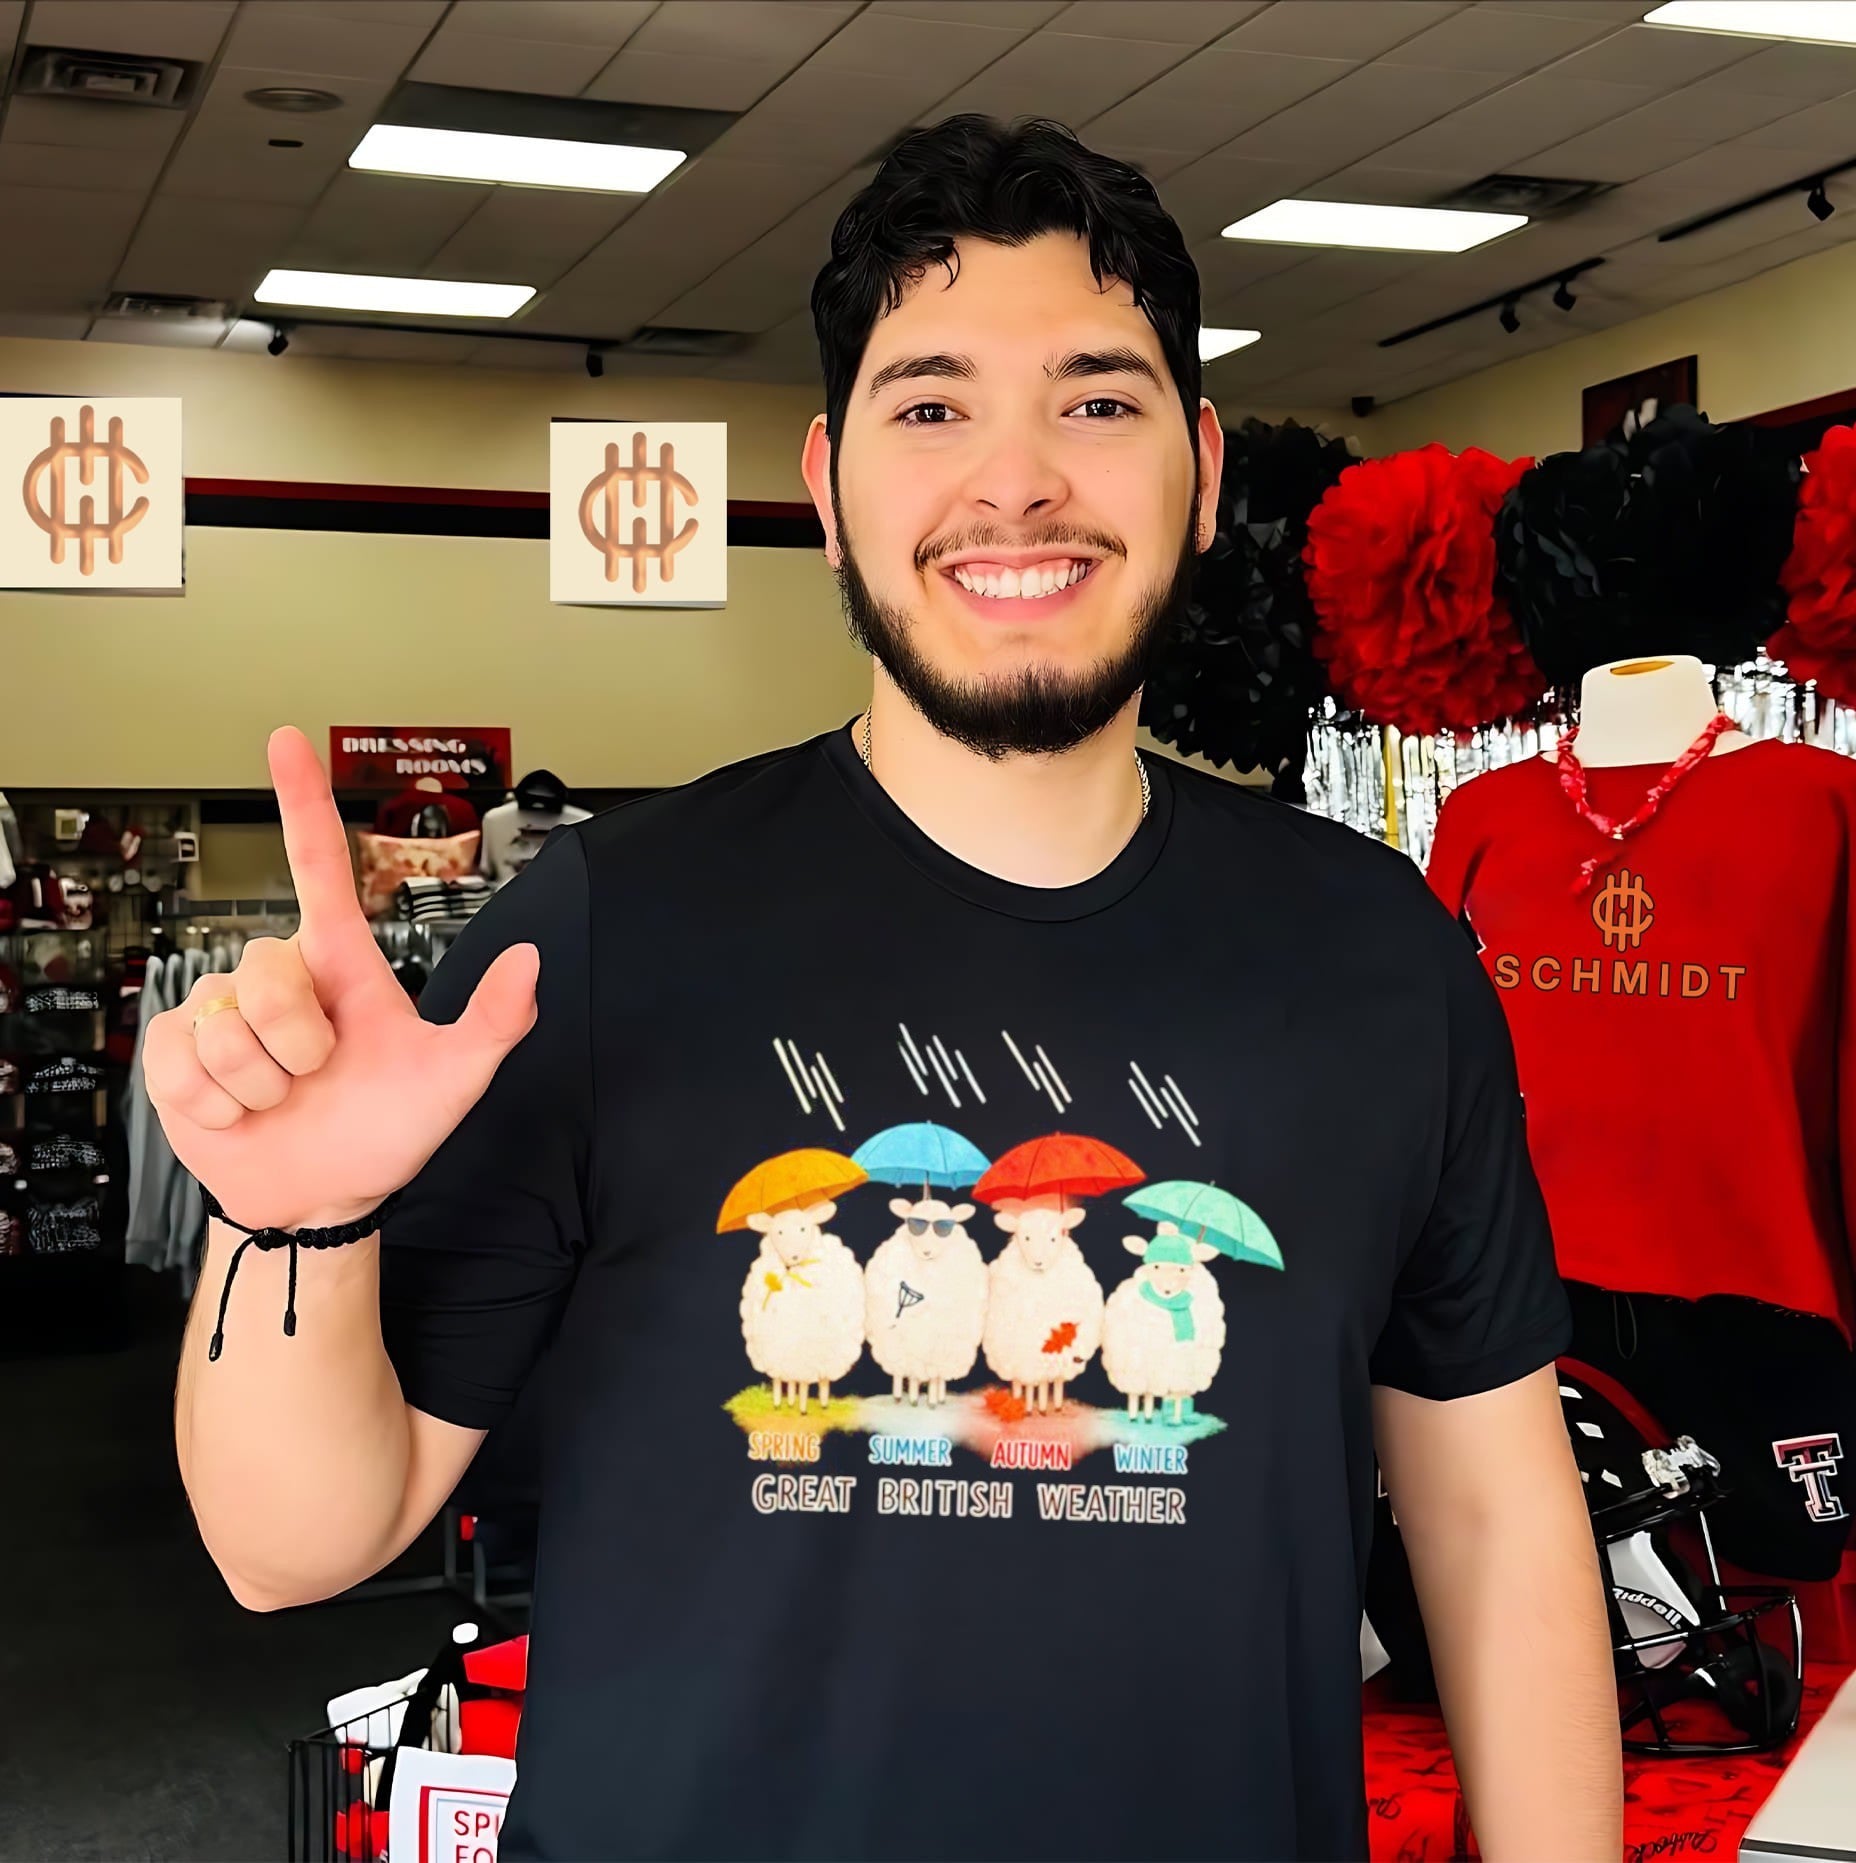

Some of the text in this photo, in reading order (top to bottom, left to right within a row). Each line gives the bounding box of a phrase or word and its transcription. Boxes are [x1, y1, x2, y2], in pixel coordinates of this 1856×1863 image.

[396, 758, 487, 774] ROOMS
[1494, 954, 1747, 1000] SCHMIDT
[748, 1431, 1188, 1474] SPRING SUMMER AUTUMN WINTER
[752, 1474, 1187, 1524] GREAT BRITISH WEATHER
